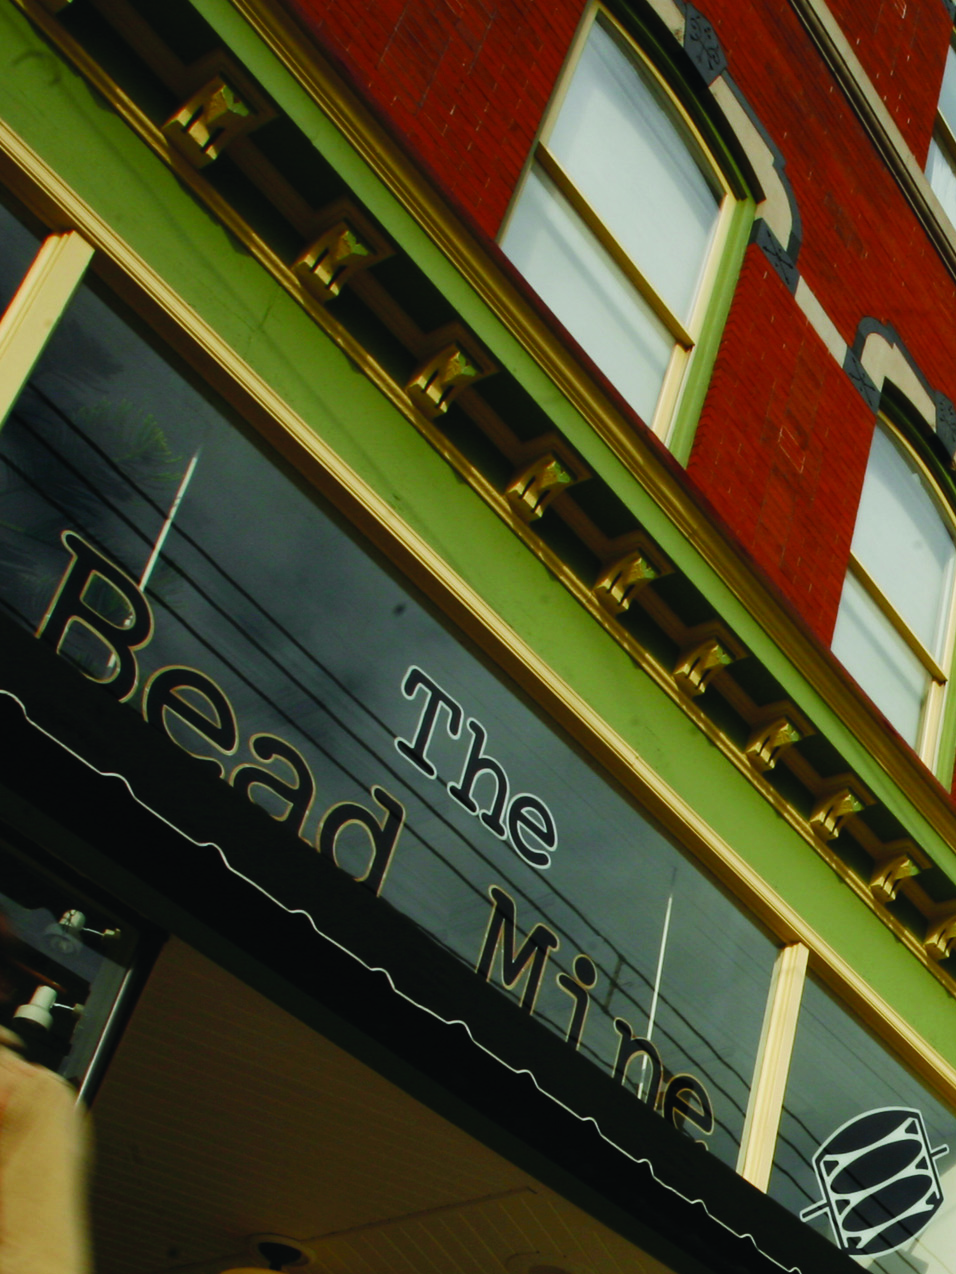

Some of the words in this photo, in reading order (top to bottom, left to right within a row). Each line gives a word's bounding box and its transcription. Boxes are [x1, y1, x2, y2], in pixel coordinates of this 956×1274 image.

[36, 529, 406, 898] Bead
[475, 884, 715, 1151] Mine
[393, 665, 558, 869] The
